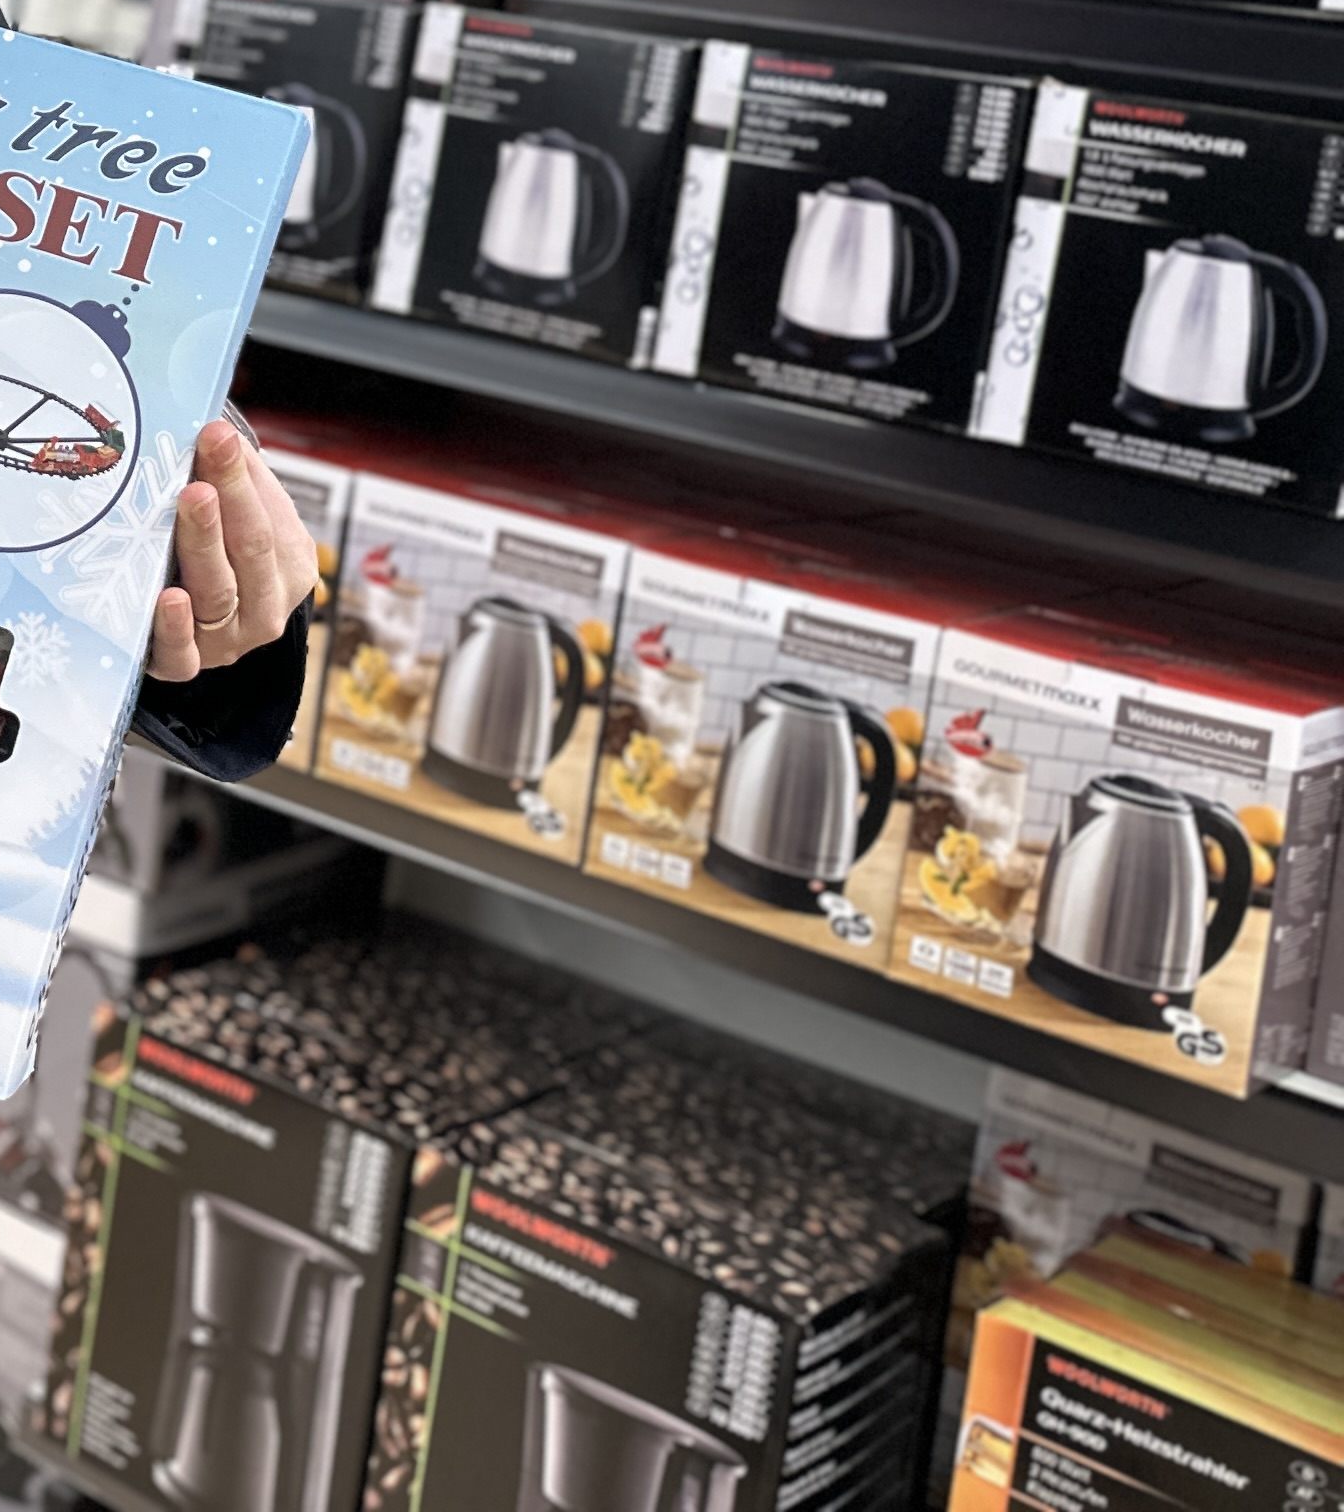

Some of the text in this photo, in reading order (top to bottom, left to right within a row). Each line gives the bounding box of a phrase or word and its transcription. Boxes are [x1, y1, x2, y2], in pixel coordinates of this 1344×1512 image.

[10, 101, 207, 194] tree
[1089, 120, 1248, 158] WASSERKOCHER
[1126, 705, 1261, 752] Wasserkocher
[1176, 1029, 1224, 1058] GS
[1046, 1353, 1171, 1419] WOOLWORTH
[1040, 1385, 1251, 1490] Quarz-Heizstrahler
